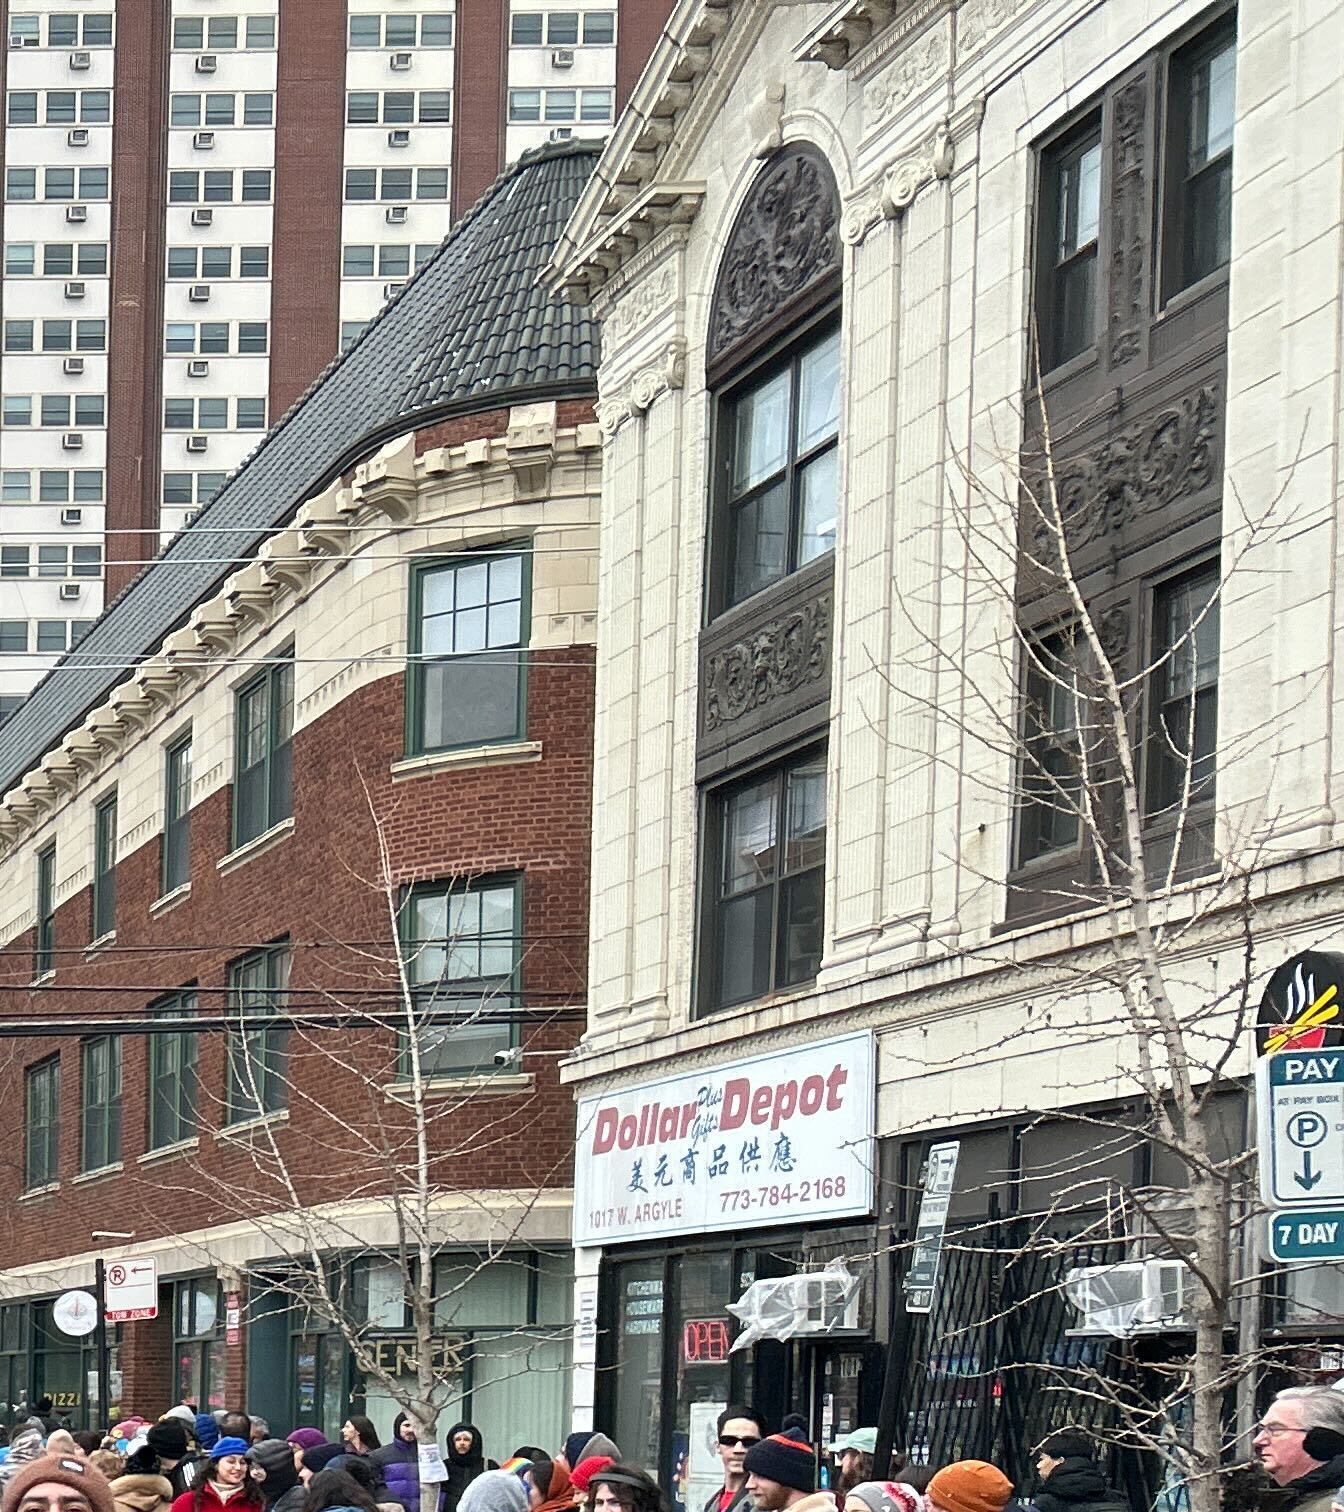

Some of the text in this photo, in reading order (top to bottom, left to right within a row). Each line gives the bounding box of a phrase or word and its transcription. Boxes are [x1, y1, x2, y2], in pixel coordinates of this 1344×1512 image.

[1286, 1057, 1339, 1082] PAY
[592, 1064, 848, 1157] Dollar Depot
[720, 1175, 846, 1213] 773-784-2168
[589, 1198, 683, 1230] 1017 W. ARGYLE
[1278, 1222, 1339, 1245] 7 DAY
[111, 1308, 151, 1319] TOW ZONE
[356, 1337, 464, 1376] CENER
[684, 1322, 730, 1360] OPEN
